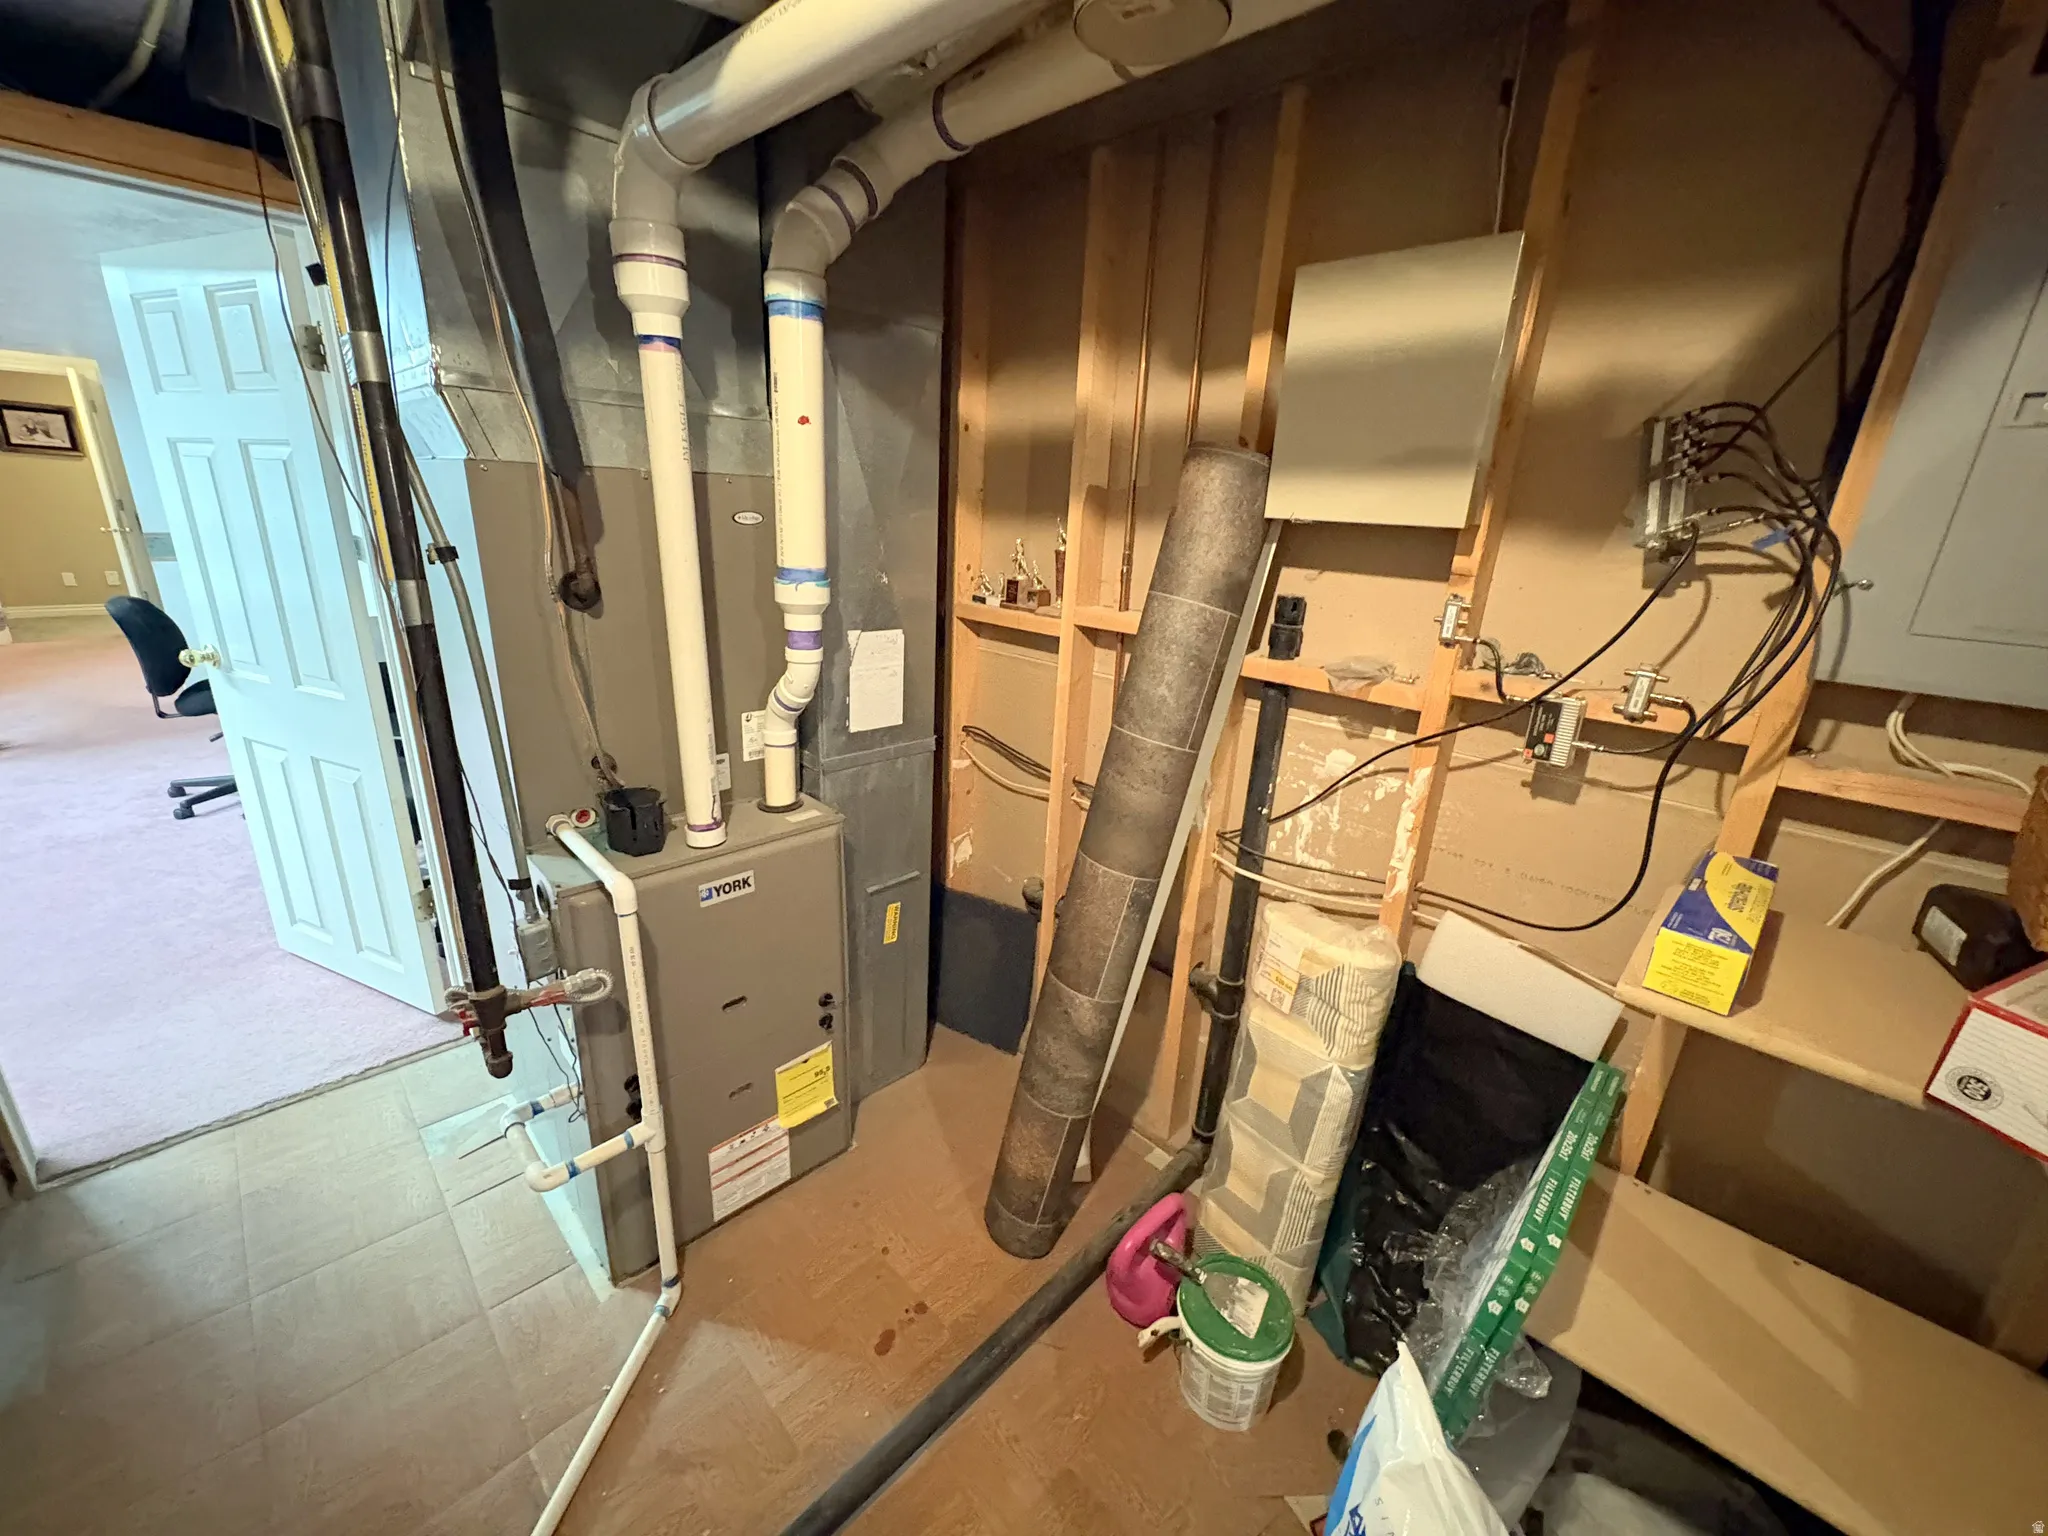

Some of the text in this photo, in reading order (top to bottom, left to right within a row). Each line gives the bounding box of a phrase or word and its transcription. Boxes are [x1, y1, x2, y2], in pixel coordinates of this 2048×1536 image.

[713, 875, 752, 898] YORK
[891, 904, 899, 940] WARNING
[1558, 1130, 1579, 1162] 20x25x1
[1580, 1131, 1599, 1162] 20x25x1
[1533, 1176, 1558, 1224] FILTERBUY
[1558, 1175, 1582, 1222] FILTERBUY
[1444, 1346, 1475, 1398] FILTERBUY
[1469, 1346, 1501, 1398] FILTERBUY
